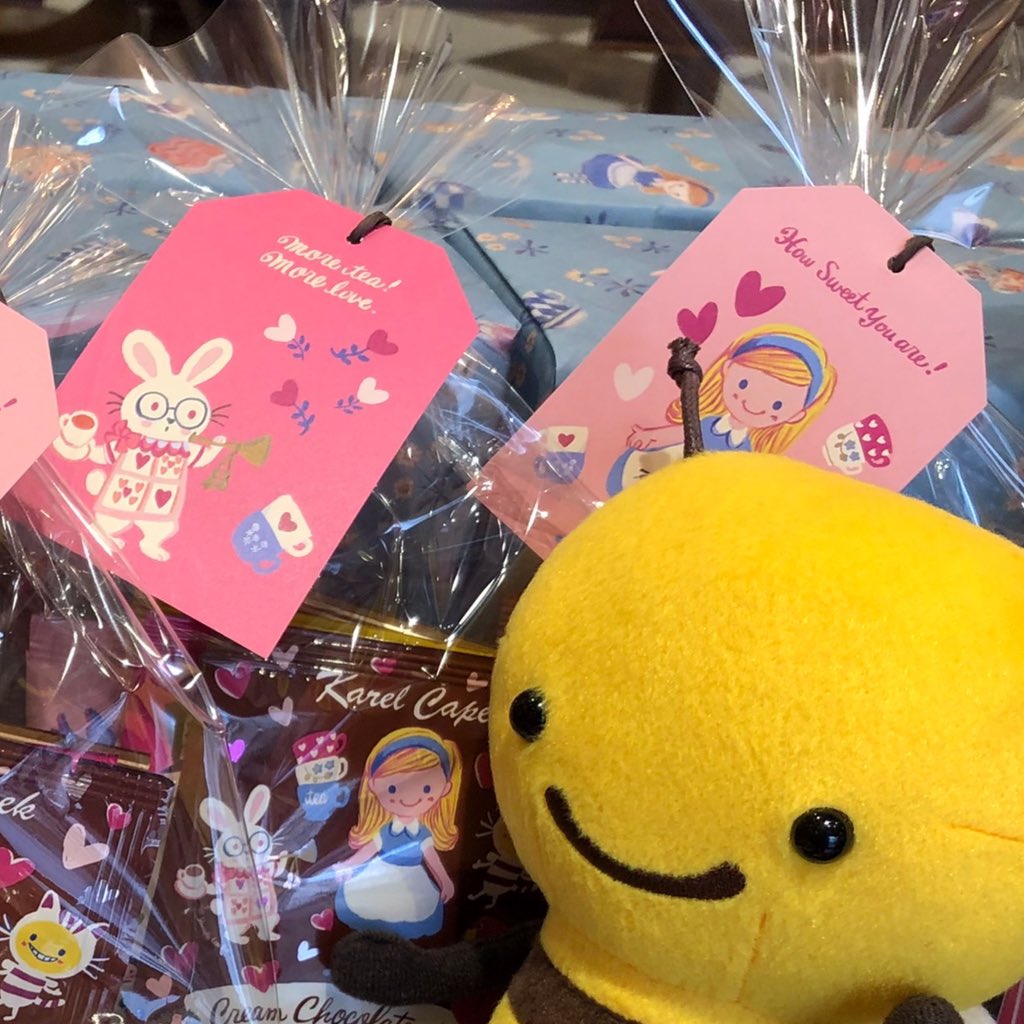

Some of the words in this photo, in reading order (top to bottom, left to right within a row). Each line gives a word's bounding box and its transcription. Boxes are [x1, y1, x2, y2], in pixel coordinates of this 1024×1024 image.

[259, 251, 328, 289] More
[323, 280, 377, 315] love.
[340, 264, 403, 293] tea!
[774, 226, 816, 268] How
[816, 260, 871, 312] Sweet
[894, 338, 948, 376] are!
[315, 670, 412, 712] Karel
[412, 682, 490, 728] Čape
[304, 789, 329, 806] tea
